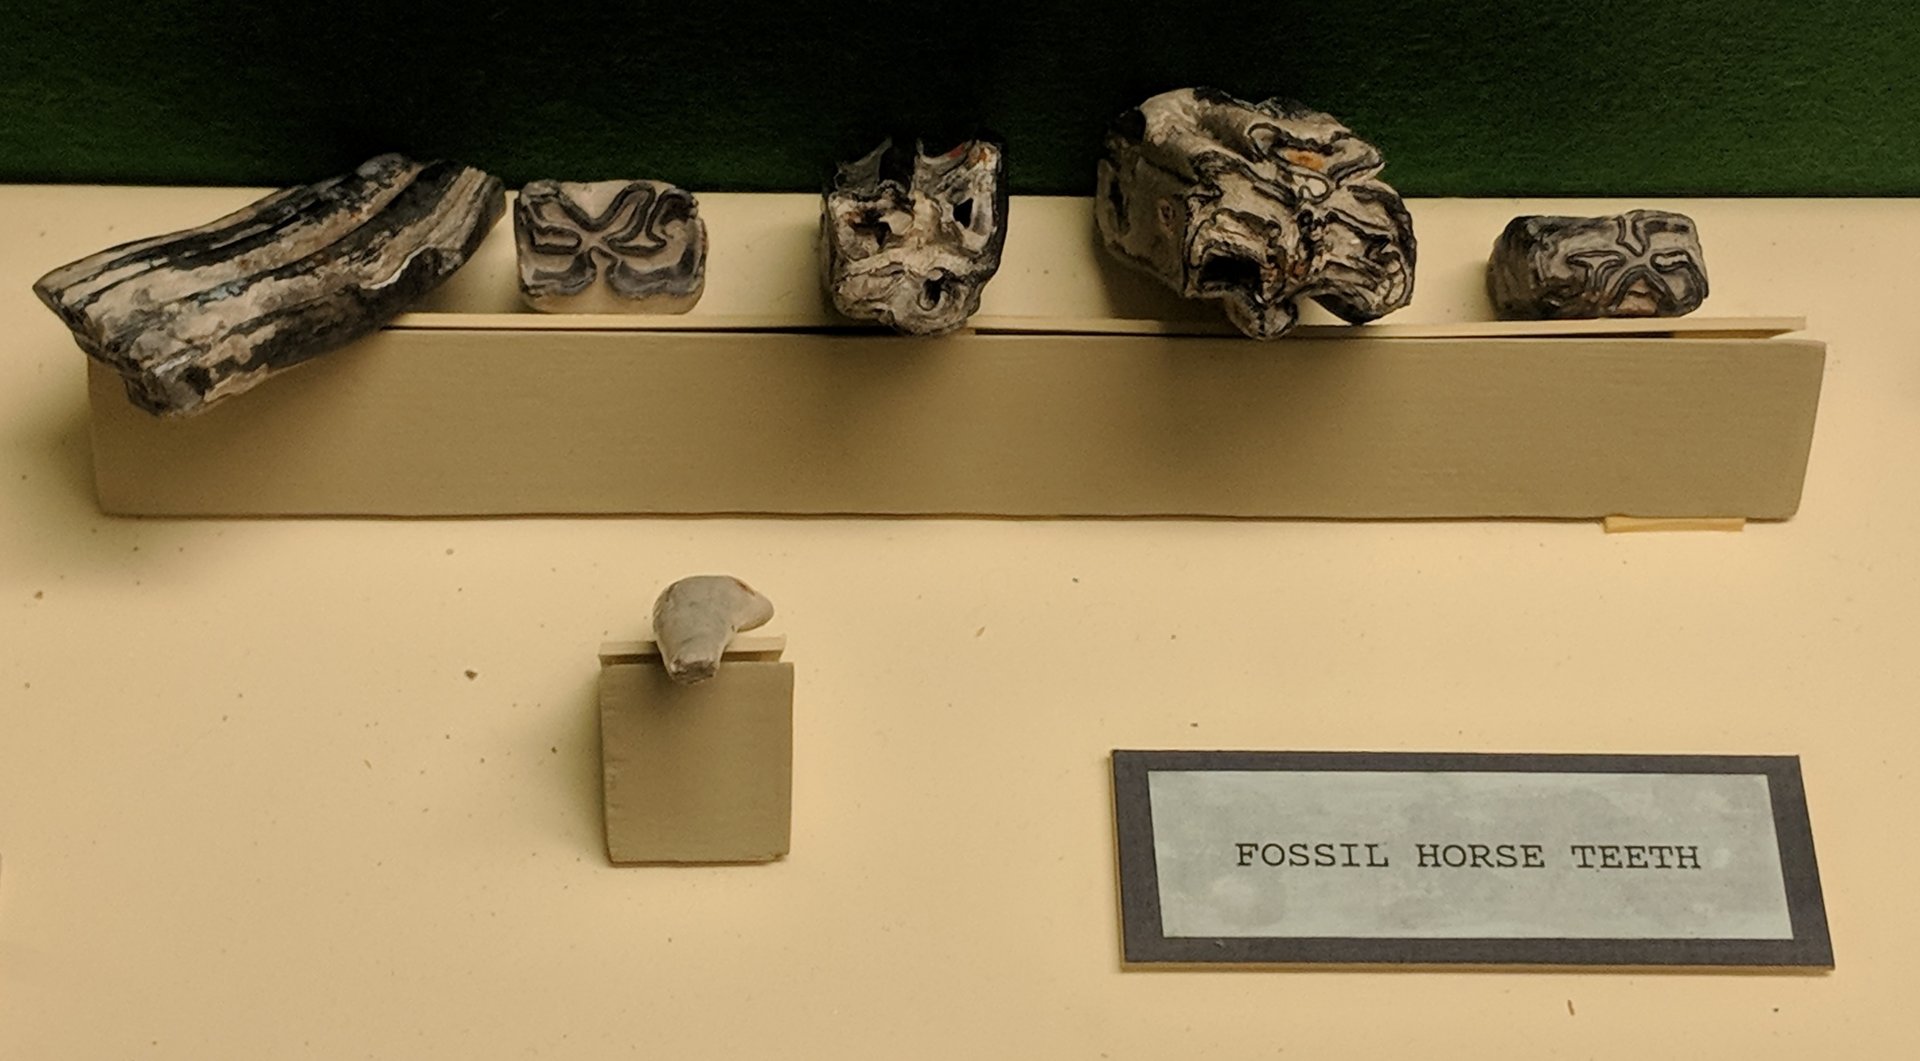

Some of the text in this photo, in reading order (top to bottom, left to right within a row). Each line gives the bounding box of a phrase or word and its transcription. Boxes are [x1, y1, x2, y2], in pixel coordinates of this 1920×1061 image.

[1235, 842, 1702, 870] FOSSIL HORSE TEETH
